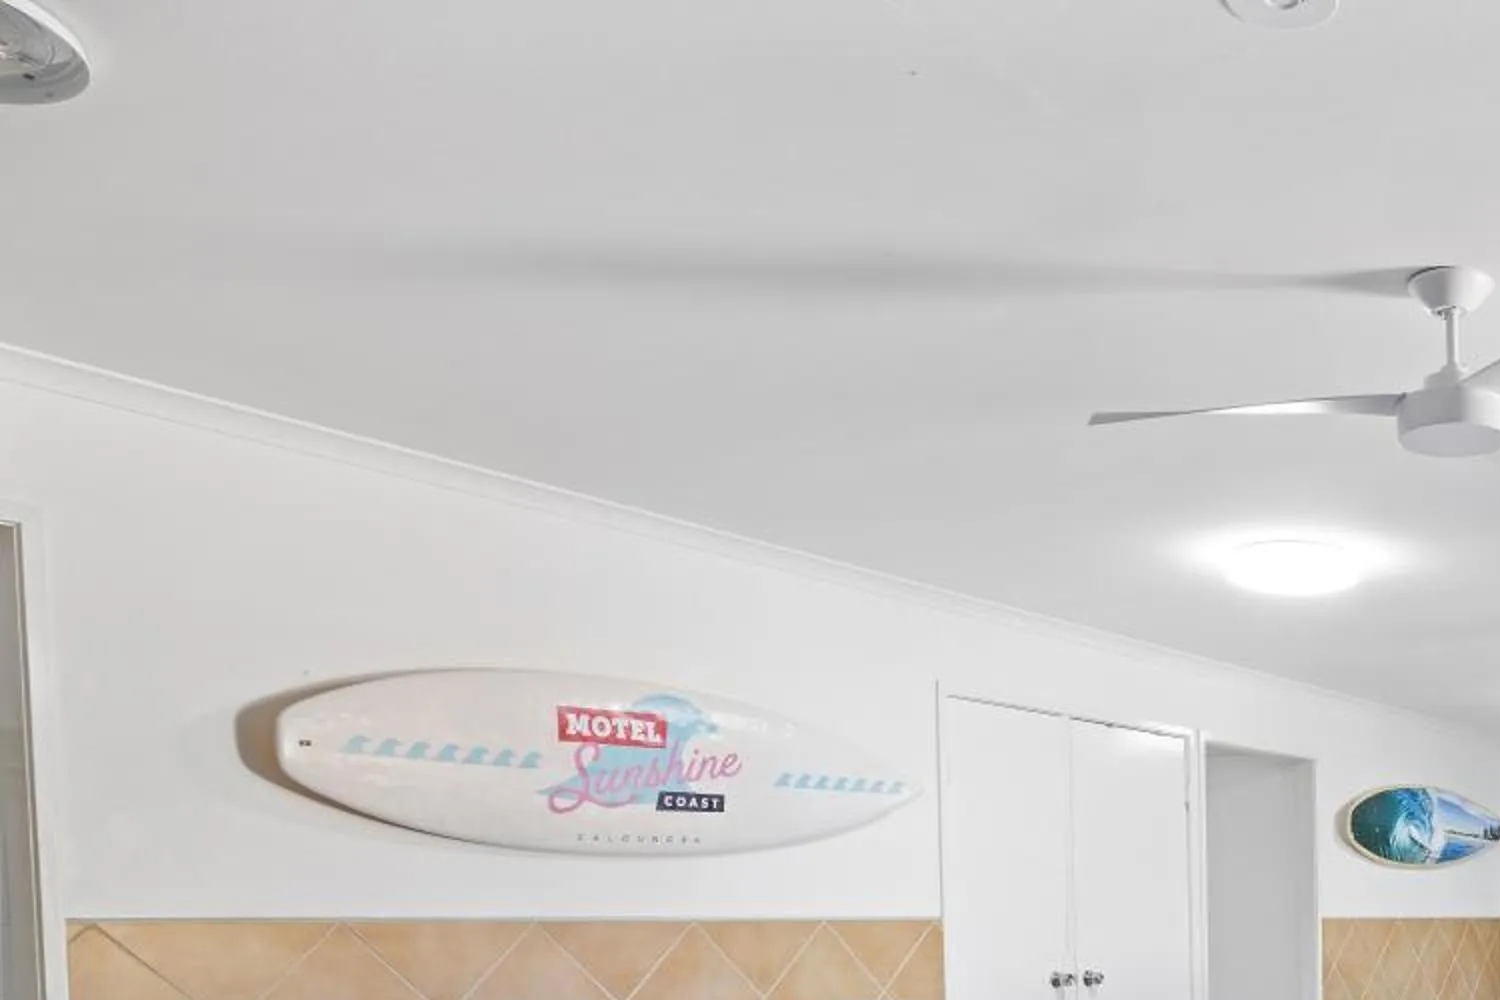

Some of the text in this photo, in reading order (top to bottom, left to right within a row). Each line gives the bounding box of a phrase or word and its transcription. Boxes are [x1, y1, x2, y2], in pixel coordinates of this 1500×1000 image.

[565, 712, 663, 743] MOTEL
[548, 738, 742, 814] Sunshine
[663, 795, 720, 809] COAST
